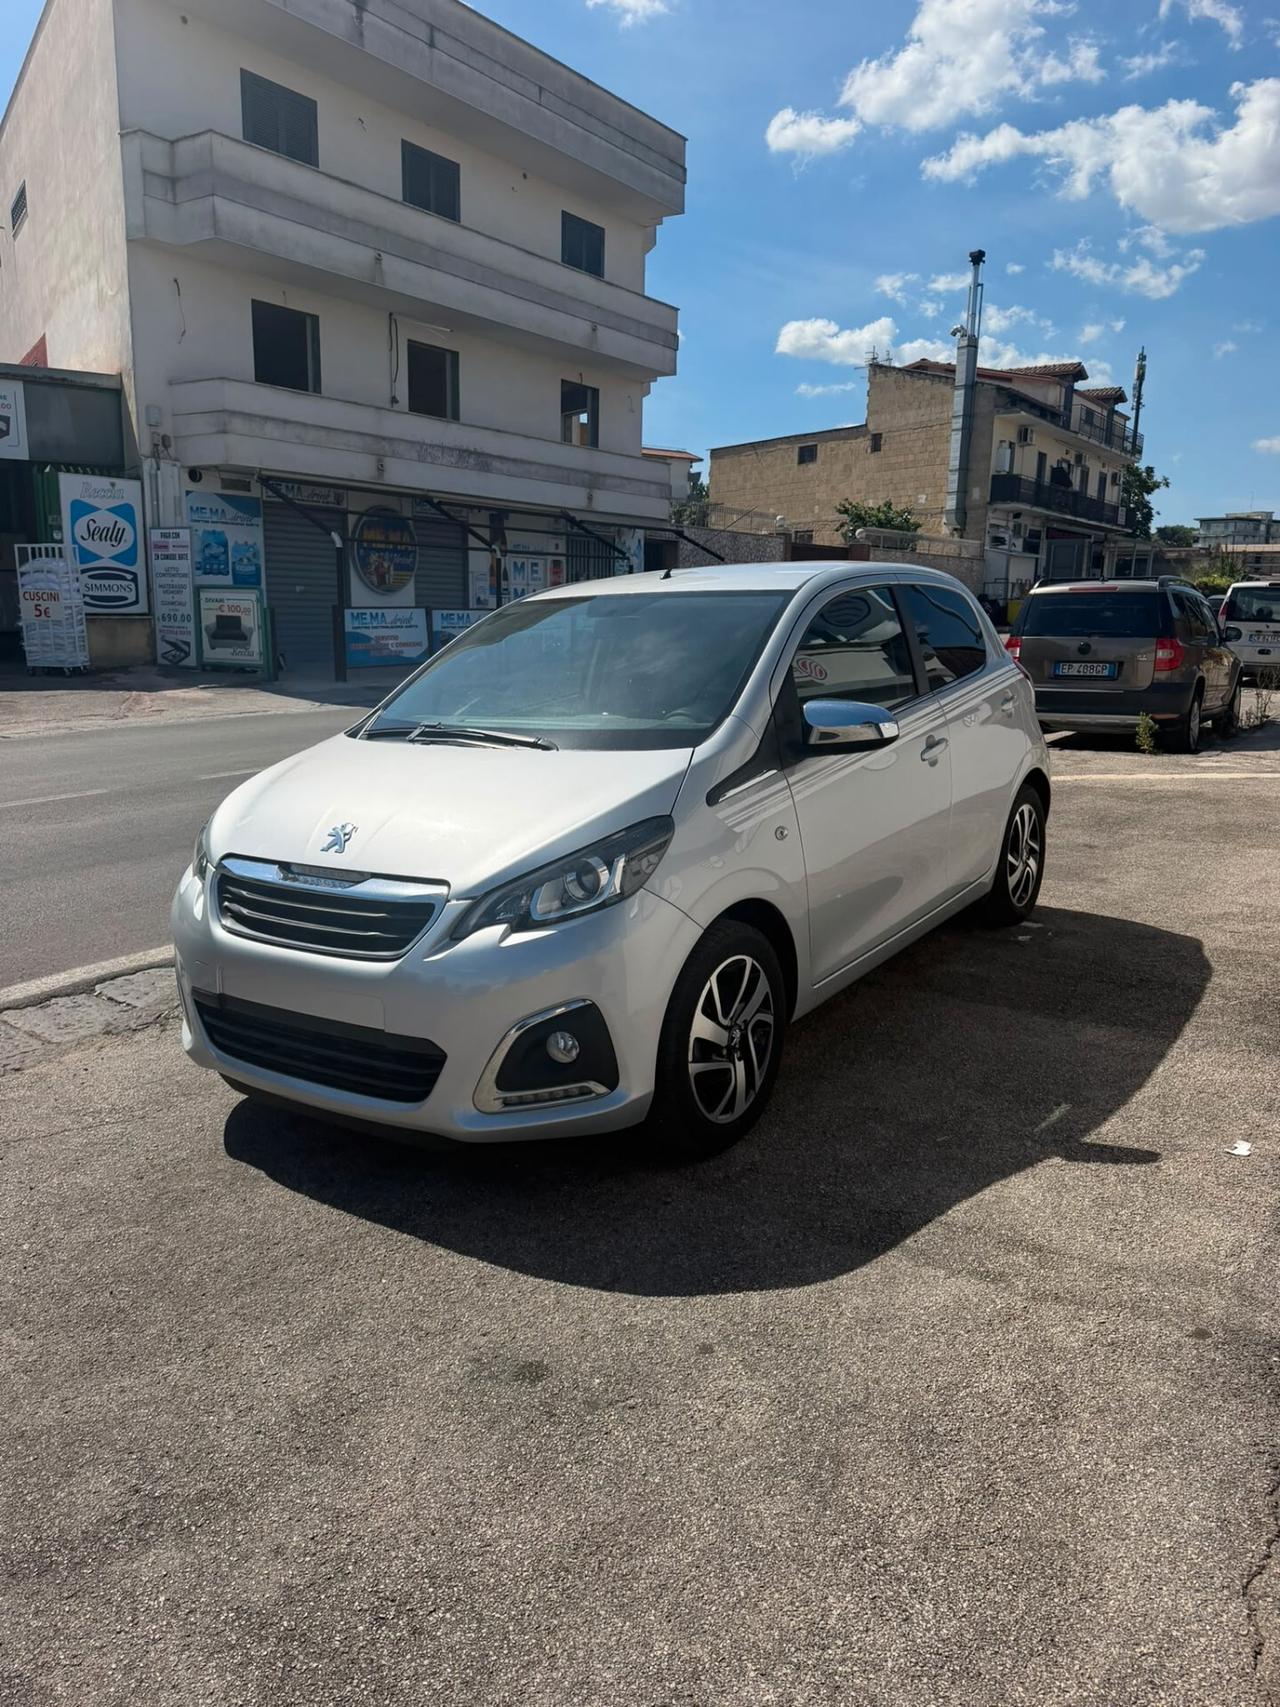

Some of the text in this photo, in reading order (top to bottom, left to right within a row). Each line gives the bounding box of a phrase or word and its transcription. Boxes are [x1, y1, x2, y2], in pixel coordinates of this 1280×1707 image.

[81, 518, 125, 548] Sealy
[84, 582, 134, 593] SIMMONS
[23, 591, 60, 602] CUSCINI
